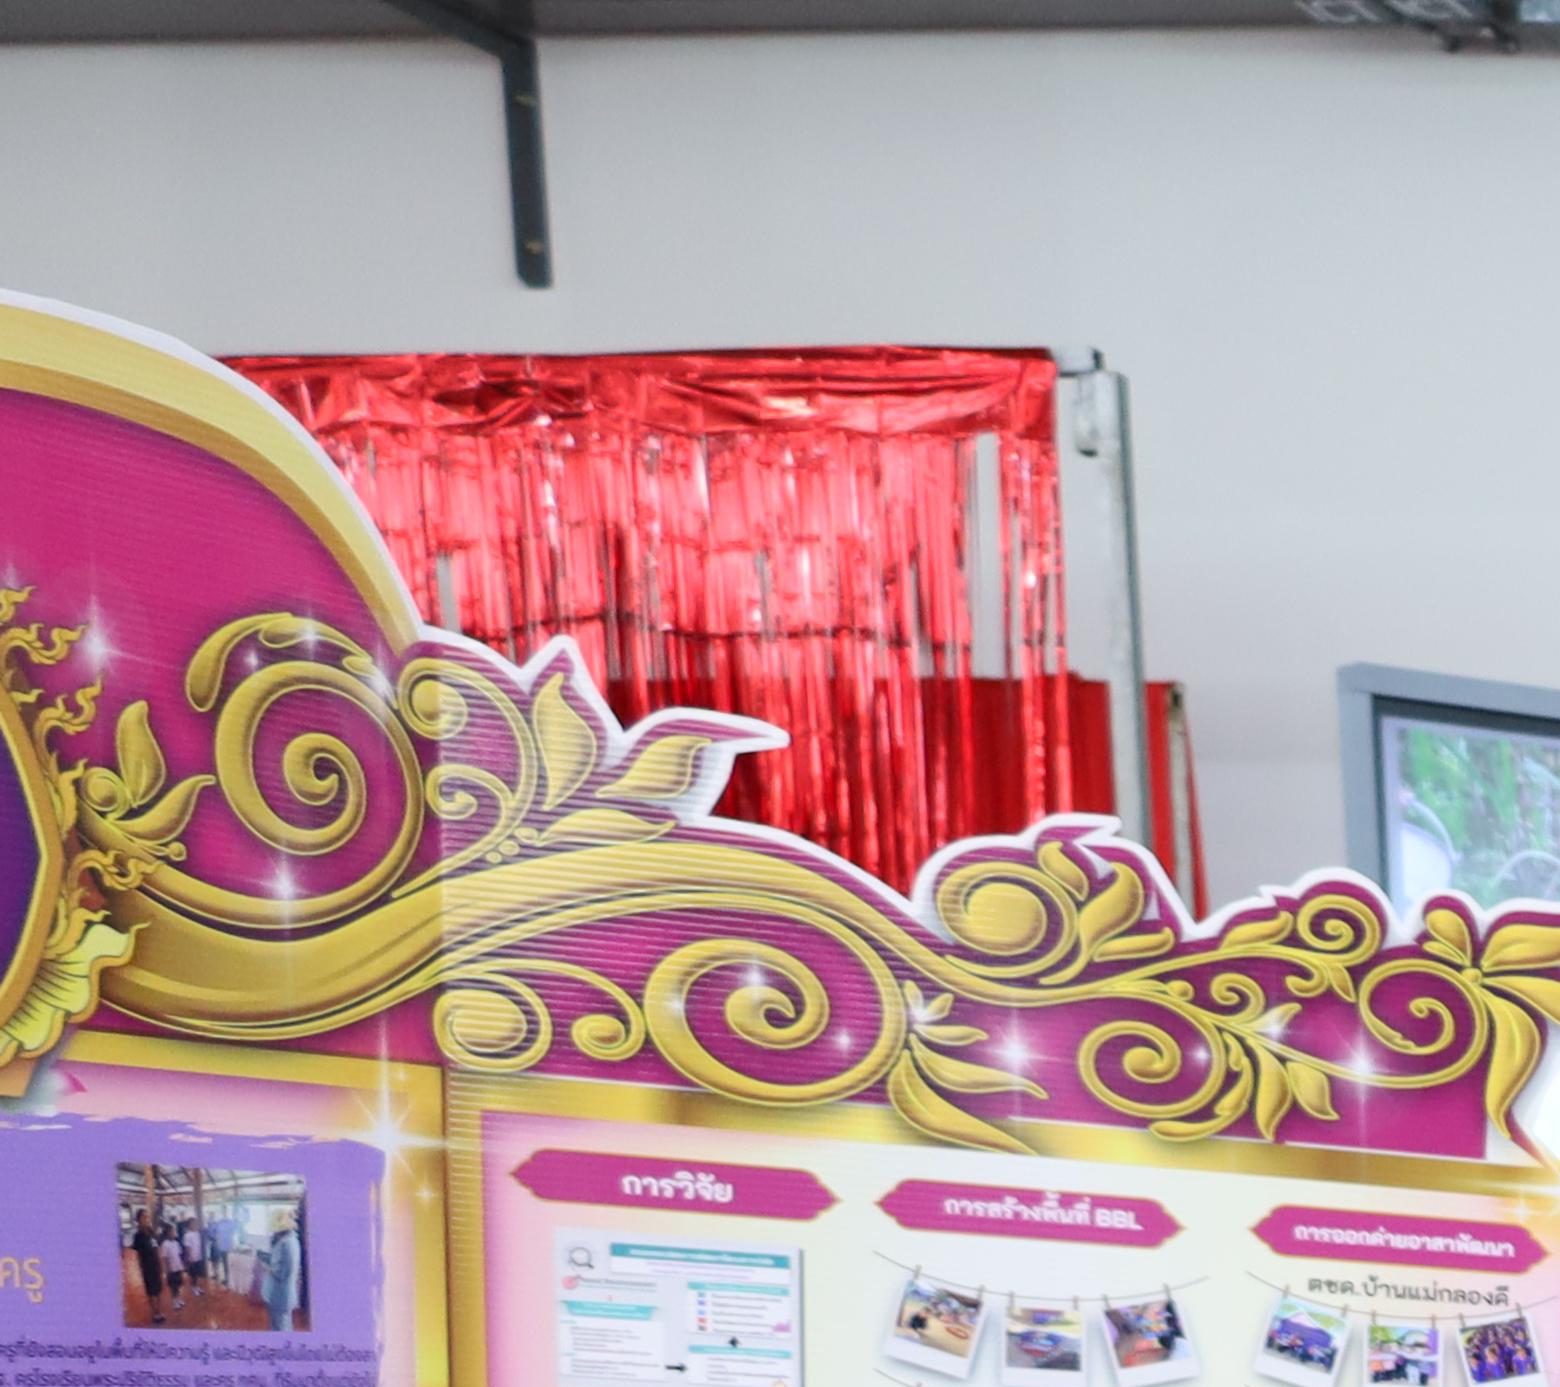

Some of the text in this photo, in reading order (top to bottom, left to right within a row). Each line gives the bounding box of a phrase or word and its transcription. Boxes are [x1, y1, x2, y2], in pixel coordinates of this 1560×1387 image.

[620, 1170, 735, 1204] การวิจัย
[943, 1191, 1145, 1231] การสร้างพื้นที่ BBL
[1293, 1225, 1516, 1258] การออกค่ายอาสาพัฒนา
